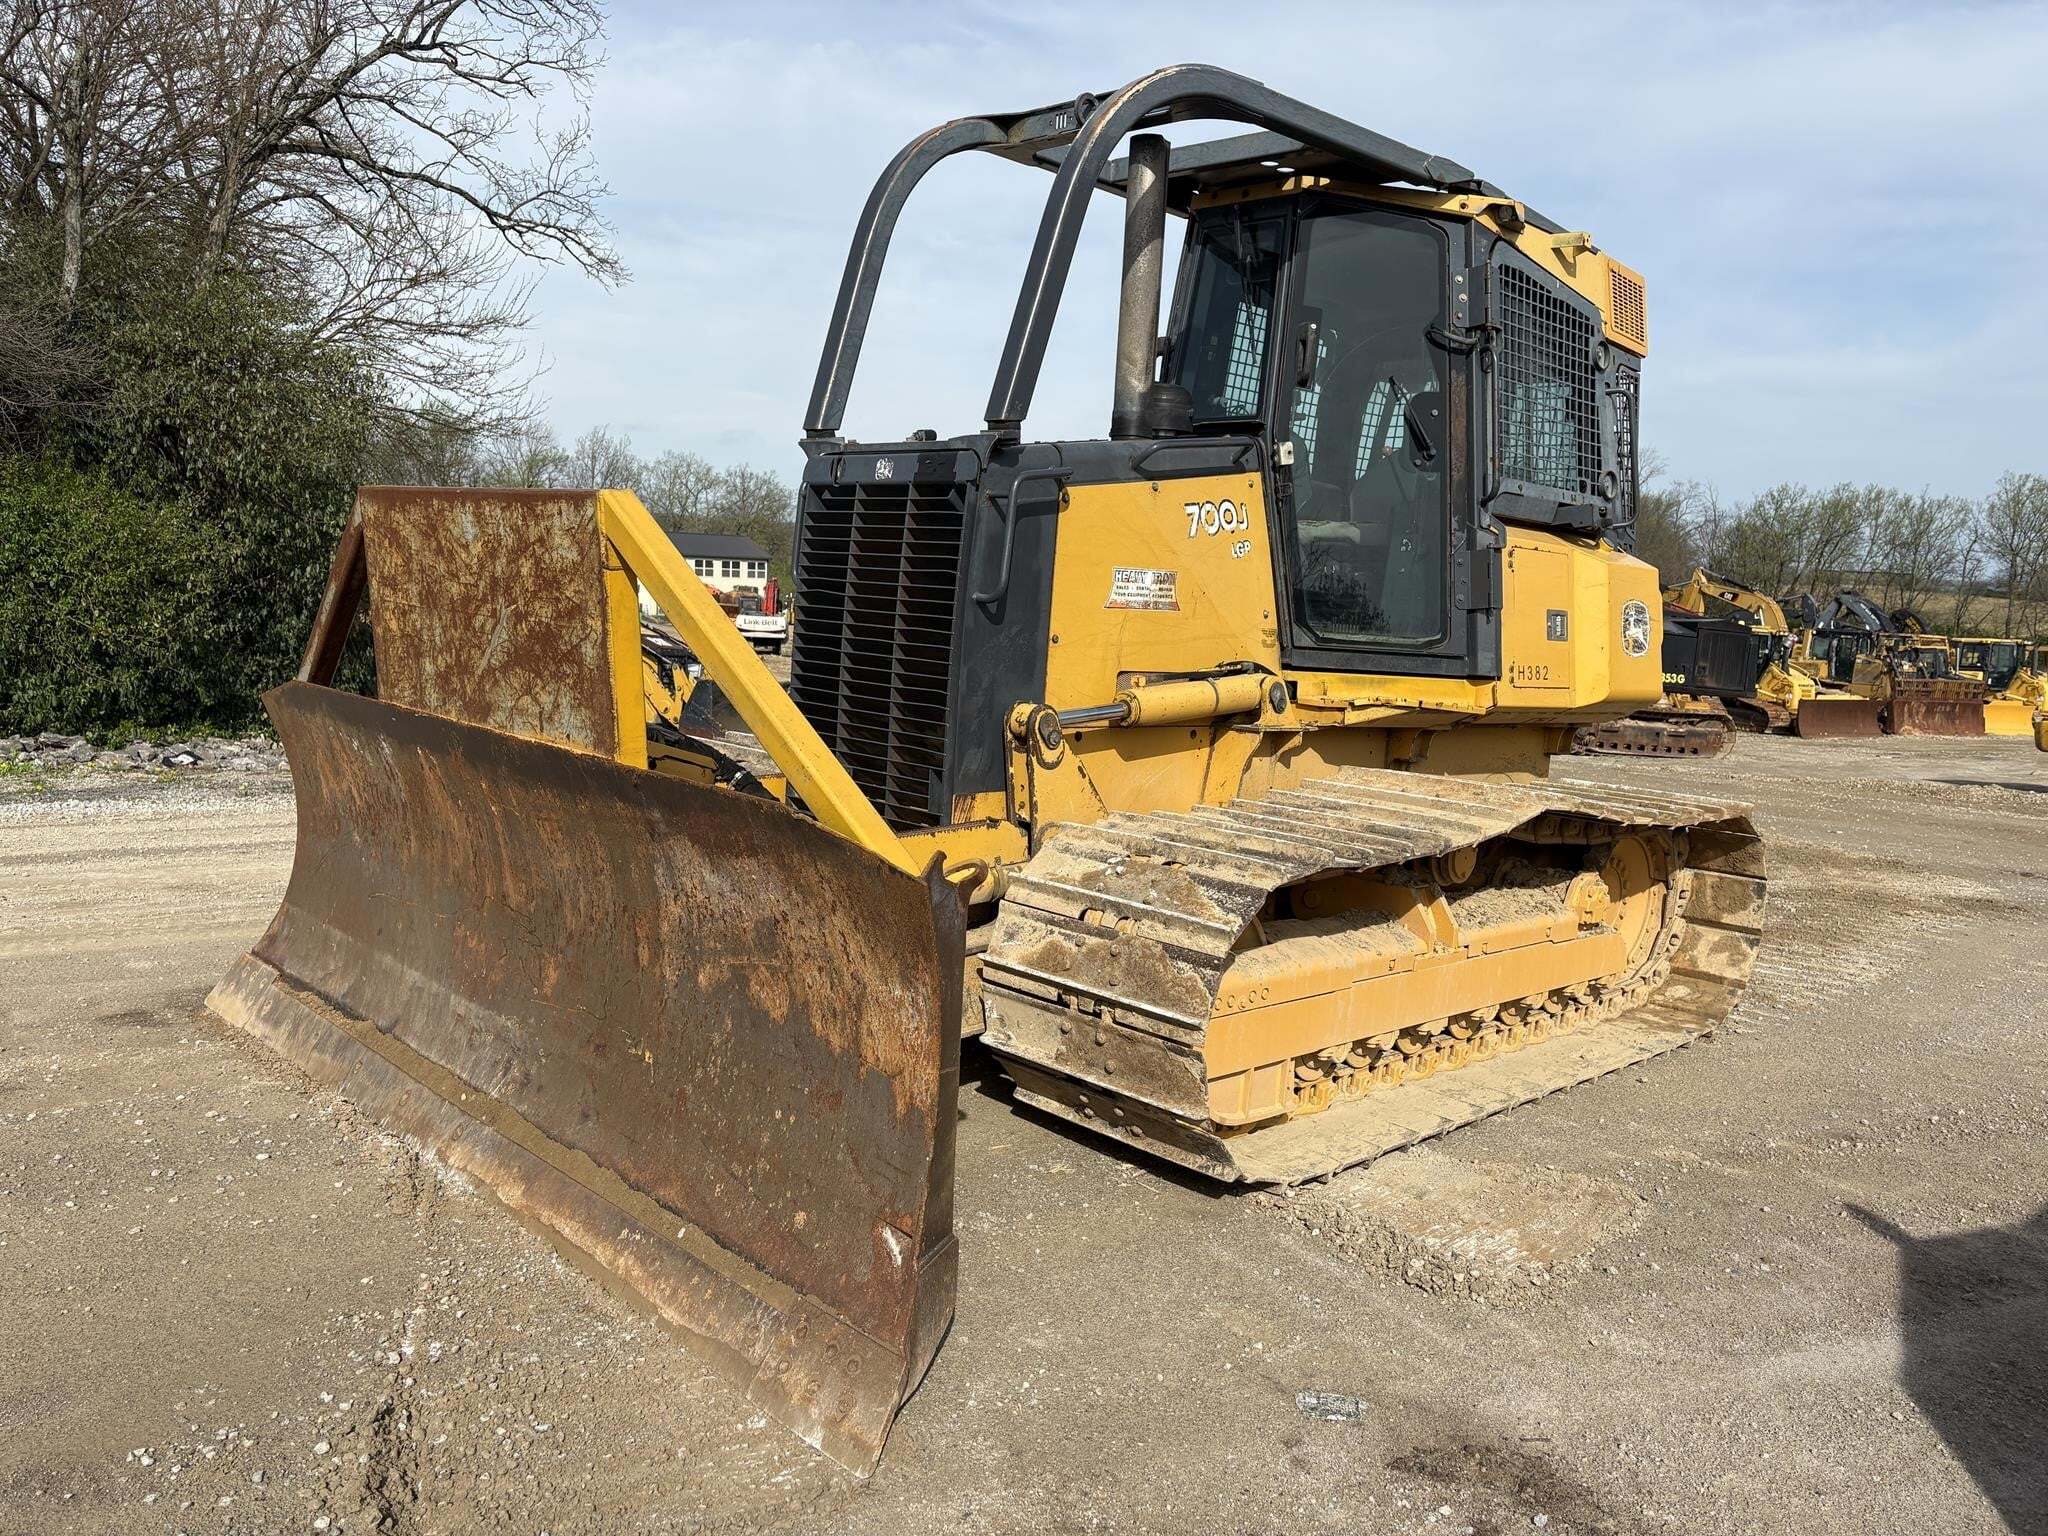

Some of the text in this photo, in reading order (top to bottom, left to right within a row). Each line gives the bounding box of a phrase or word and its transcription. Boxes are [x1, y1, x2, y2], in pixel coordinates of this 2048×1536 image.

[1184, 499, 1249, 538] 700J
[1231, 540, 1251, 559] LGP
[1115, 570, 1149, 584] HEAVY
[1518, 665, 1549, 681] H382
